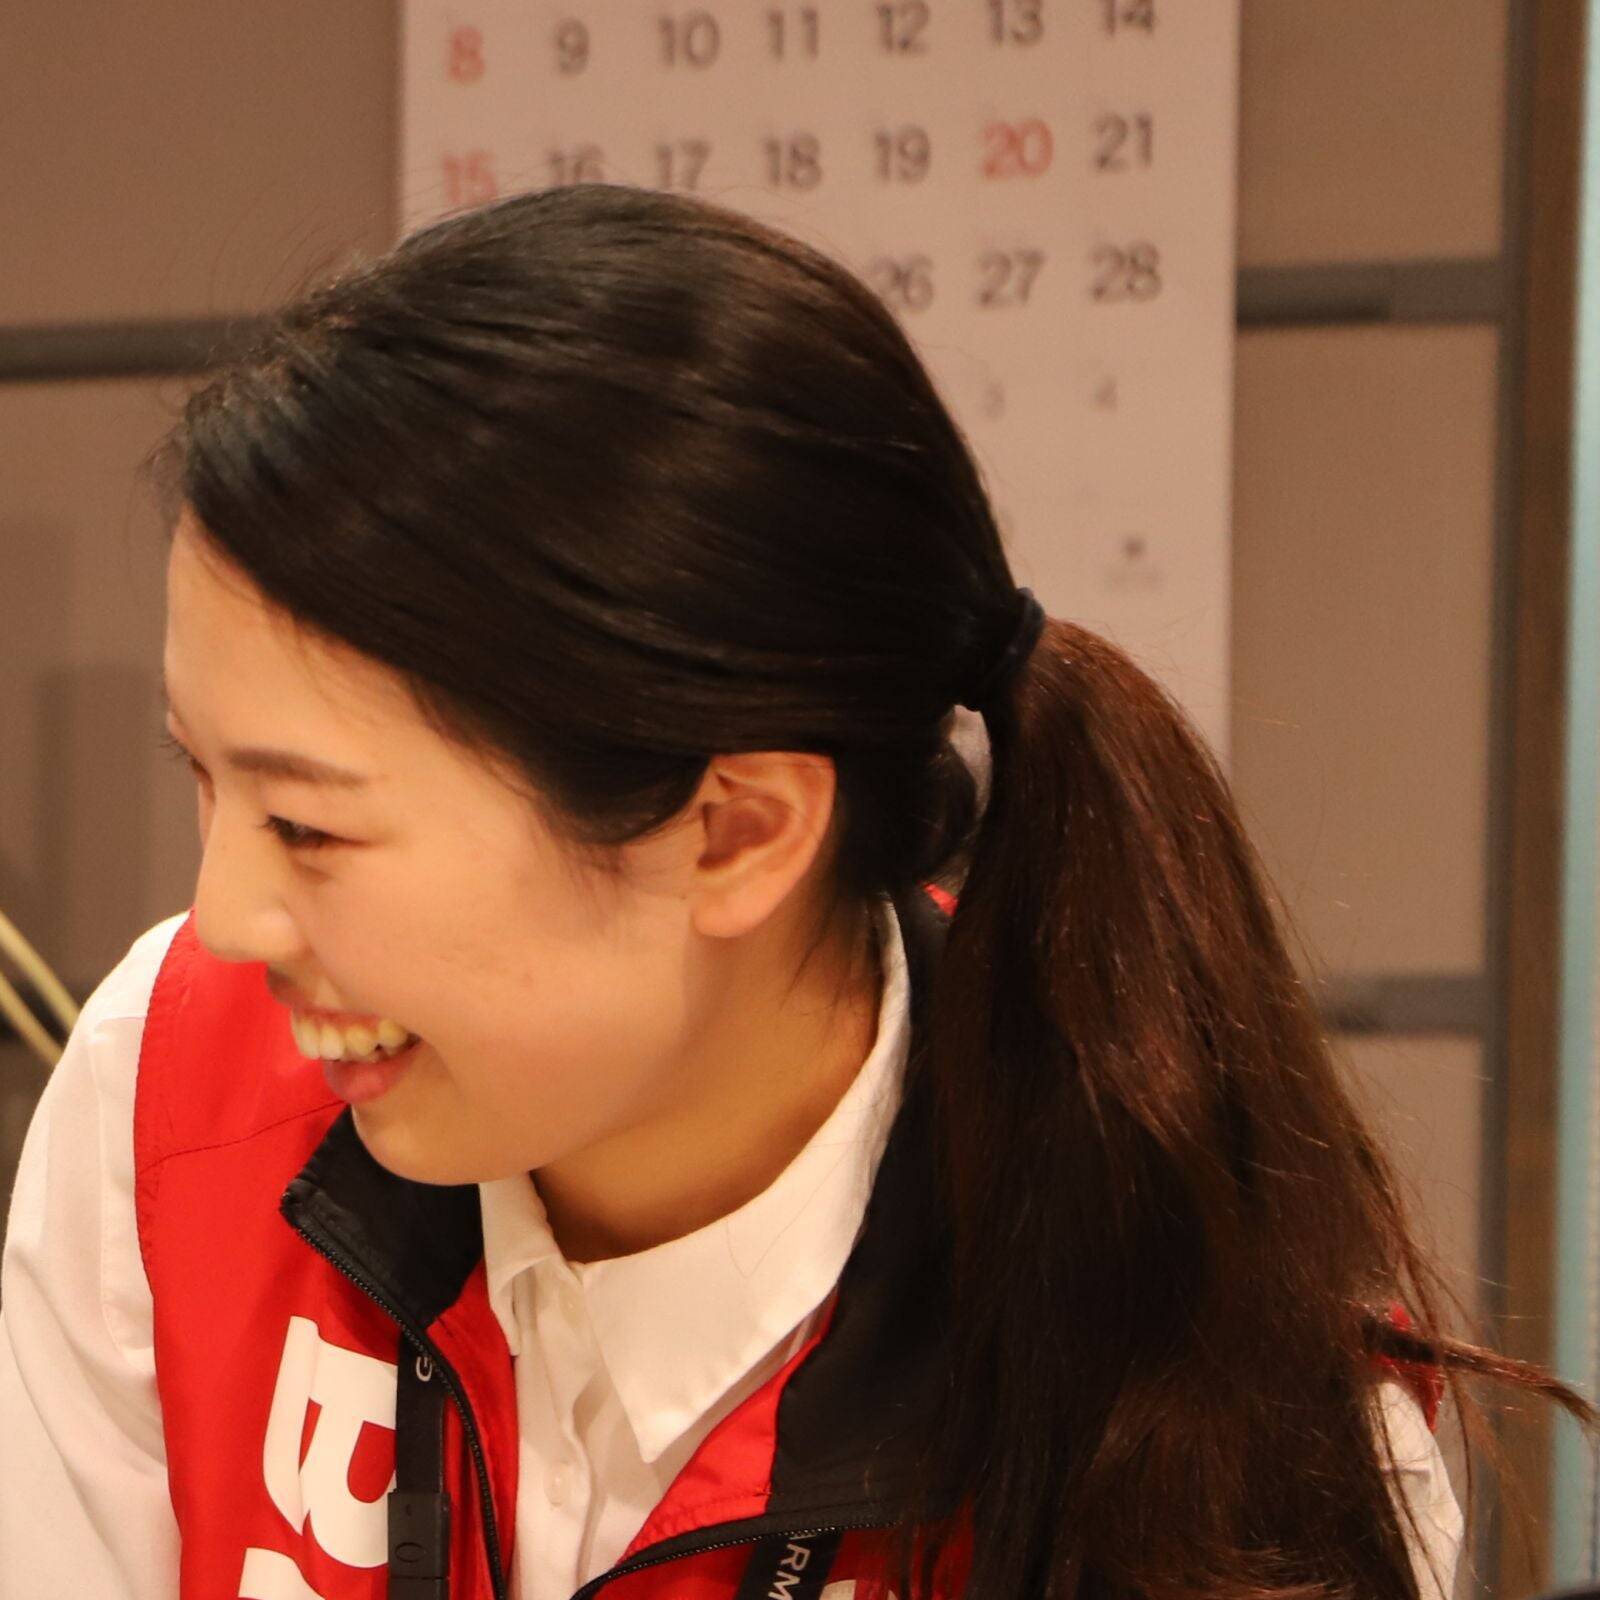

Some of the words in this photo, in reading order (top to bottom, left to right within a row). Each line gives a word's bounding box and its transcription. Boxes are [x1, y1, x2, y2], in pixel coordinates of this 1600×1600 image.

[448, 23, 486, 86] 8
[555, 16, 590, 77] 9
[657, 10, 720, 71] 10
[767, 7, 819, 60] 11
[878, 0, 930, 54] 12
[990, 0, 1044, 47] 13
[441, 149, 497, 206] 15
[655, 138, 709, 192] 17
[763, 133, 823, 191] 18
[874, 125, 930, 184] 19
[983, 118, 1053, 180] 20
[1096, 114, 1152, 173] 21
[980, 249, 1044, 306] 27
[1093, 242, 1162, 300] 28
